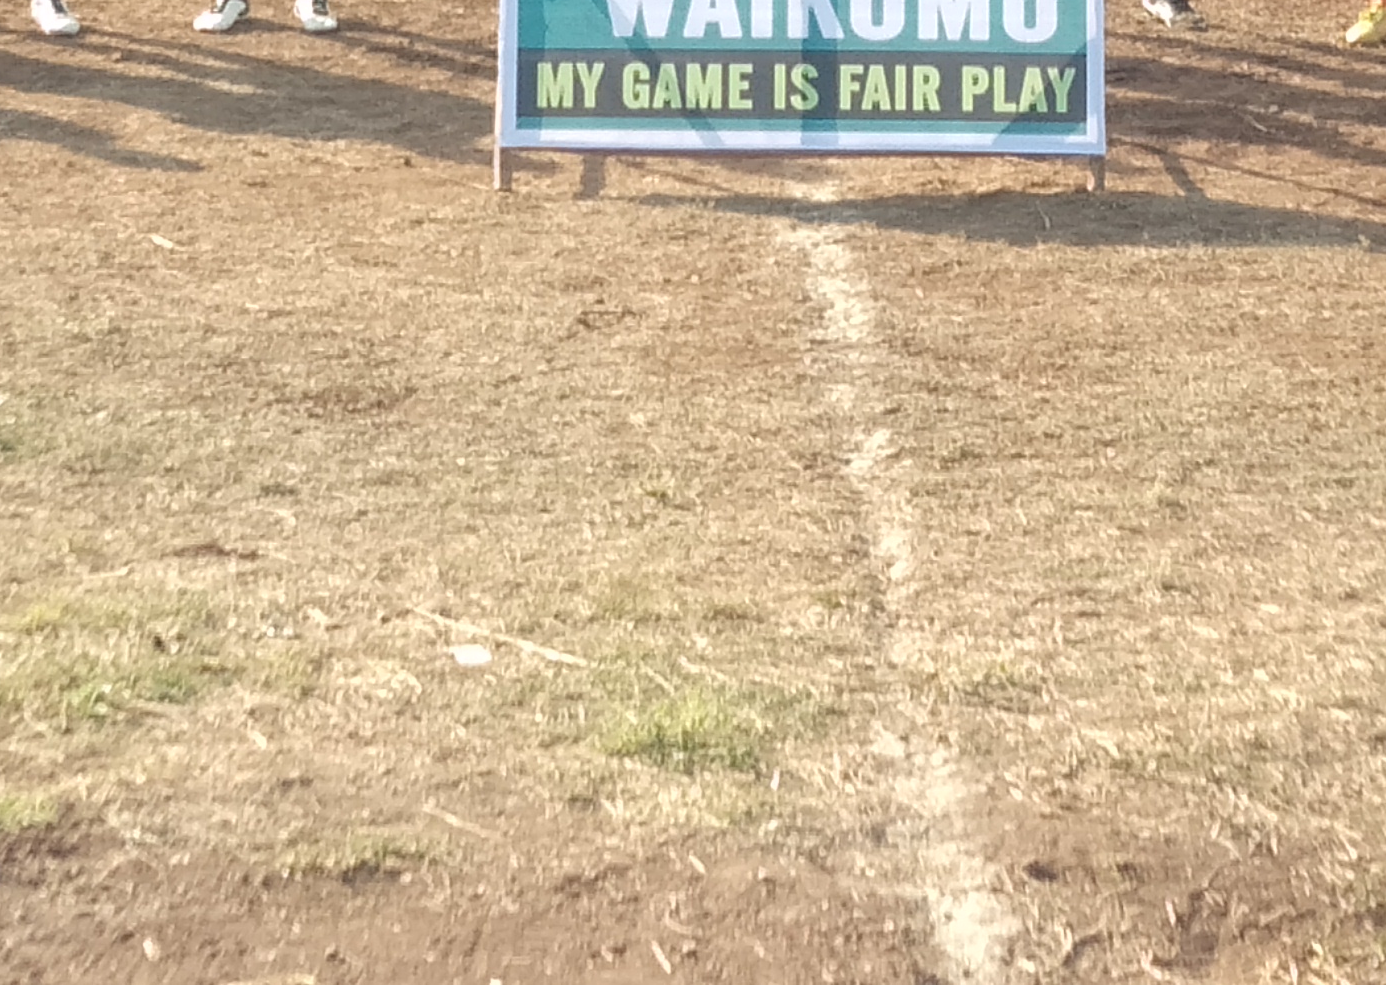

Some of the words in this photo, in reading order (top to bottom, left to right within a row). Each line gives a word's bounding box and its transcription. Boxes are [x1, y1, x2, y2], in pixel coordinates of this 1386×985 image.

[537, 61, 606, 110] MY
[622, 62, 754, 111] GAME
[773, 63, 819, 111] IS
[840, 64, 941, 112] FAIR
[961, 65, 1077, 115] PLAY
